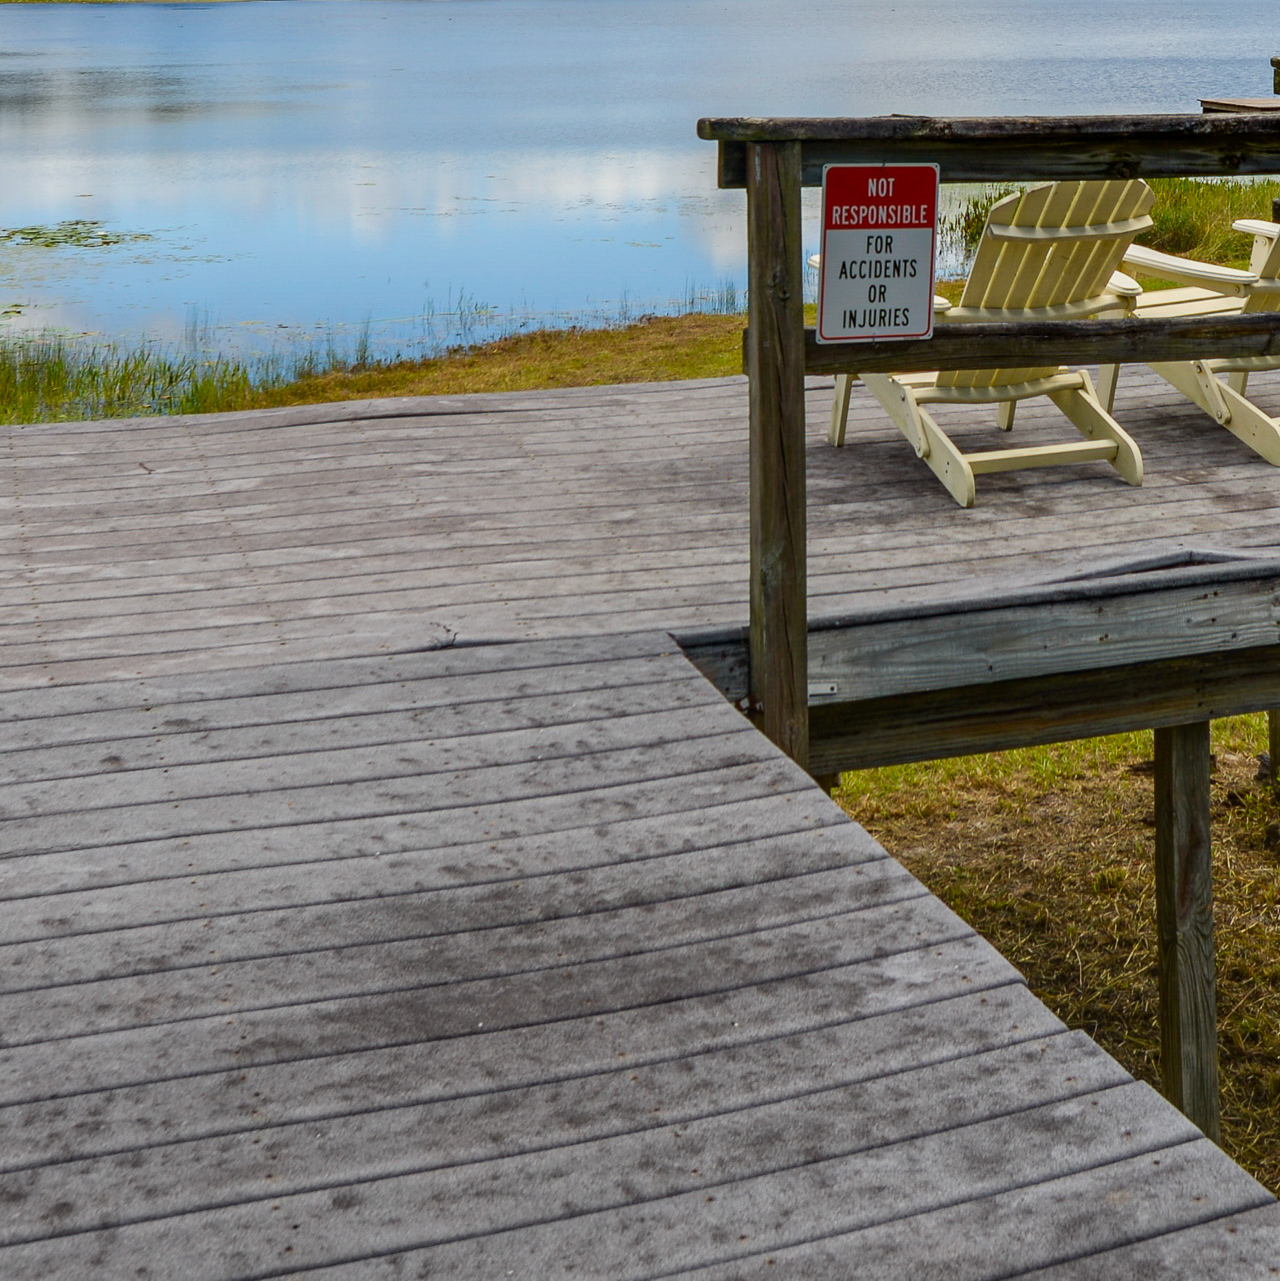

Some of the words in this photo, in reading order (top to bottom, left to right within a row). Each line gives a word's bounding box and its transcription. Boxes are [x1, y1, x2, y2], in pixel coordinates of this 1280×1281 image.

[868, 178, 895, 197] NOT
[832, 204, 928, 225] RESPONSIBLE
[866, 235, 893, 254] FOR
[838, 259, 917, 279] ACCIDENTS
[868, 285, 886, 303] OR
[842, 308, 910, 328] INJURIES
